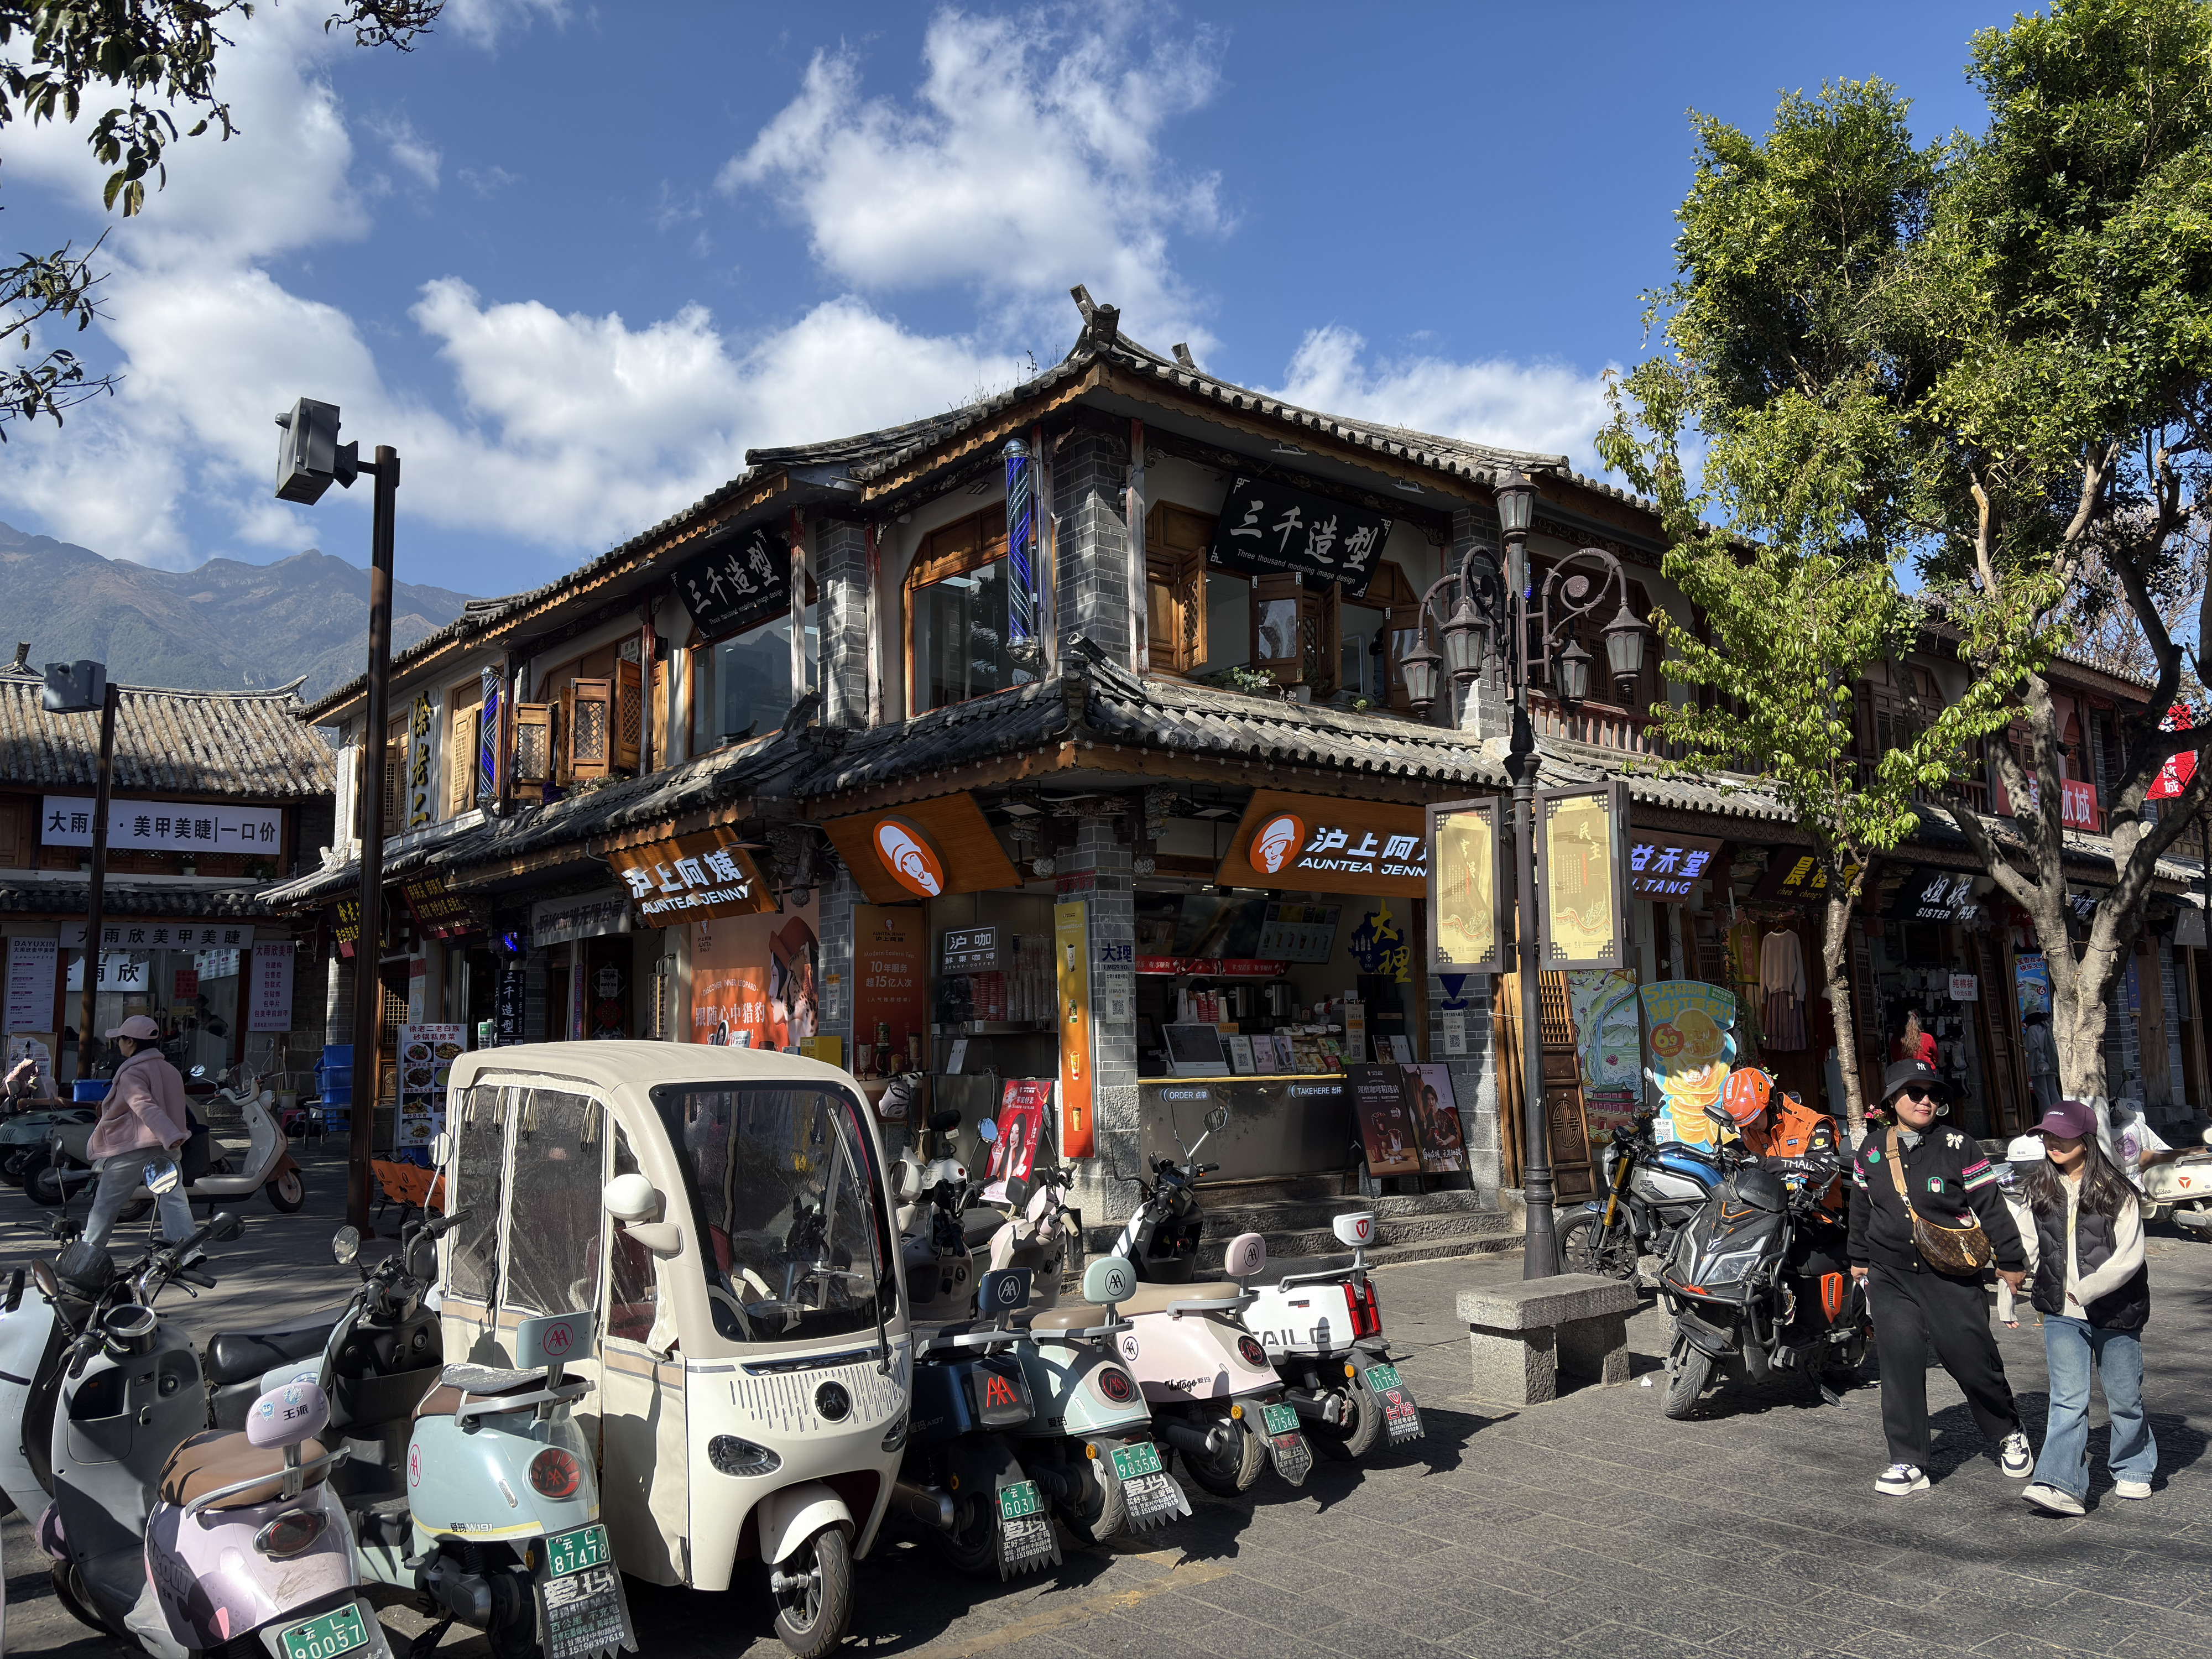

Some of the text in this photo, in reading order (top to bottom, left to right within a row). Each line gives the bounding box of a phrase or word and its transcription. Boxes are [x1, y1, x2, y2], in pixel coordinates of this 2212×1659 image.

[1230, 500, 1378, 572] 三千造型
[1238, 549, 1355, 585] Three thousand modeling image design
[687, 541, 780, 614] 三千造型
[708, 589, 784, 625] Three thousand modeling image design
[1305, 828, 1427, 860] 沪上阿
[1579, 821, 1601, 861] 民主
[1297, 858, 1373, 873] AUNTEA
[1631, 844, 1710, 878] 益禾堂
[621, 850, 743, 899] 沪上阿姨
[641, 884, 750, 915] AUNTEA JENNY
[1777, 887, 1793, 896] chen
[1916, 904, 1978, 920] SISTER 内衣
[949, 932, 992, 950] 沪咖
[1371, 899, 1412, 984] 大理
[255, 945, 293, 957] 大雨欣美甲
[945, 952, 995, 964] 鲜果咖啡
[1102, 943, 1132, 962] 大理
[67, 963, 140, 983] 雨欣
[870, 961, 907, 973] 10年服务
[2020, 963, 2044, 973] 快乐久久
[703, 981, 722, 996] DISCOVER
[738, 979, 757, 992] LEOPARD
[865, 975, 912, 988] 超15亿人次
[1952, 978, 1974, 988] 纯棉袜
[1642, 983, 1707, 1003] 5片鲜切橙
[501, 972, 516, 1034] 三千造型
[695, 1001, 765, 1027] 跟随心中猎豹
[1655, 1029, 1678, 1048] 6.9
[1169, 1091, 1207, 1100] ORDER 点单
[1331, 1086, 1342, 1094] 出杯
[1358, 1085, 1399, 1094] 现磨咖啡精选店
[1781, 1159, 1815, 1171] TMALL
[2154, 1188, 2172, 1197] yadea
[1165, 1379, 1197, 1392] Vintage
[1375, 1374, 1400, 1390] J1756
[283, 1404, 309, 1421] 王派
[1386, 1401, 1415, 1421] 台铃
[927, 1416, 944, 1426] A107
[1047, 1416, 1067, 1427] 爱玛
[1270, 1415, 1297, 1432] H7546
[1390, 1426, 1419, 1437] 15825170329
[1123, 1447, 1146, 1460] 云 A
[1279, 1446, 1305, 1460] 爱玛
[1119, 1456, 1159, 1477] 9835R
[1010, 1486, 1034, 1498] 云 L
[1123, 1474, 1169, 1498] 爱玛
[1005, 1495, 1043, 1516] G0314
[1126, 1486, 1175, 1506] 买好车 选爱玛
[1002, 1512, 1046, 1542] 爱玛
[562, 1530, 597, 1551] 云 L
[1003, 1530, 1050, 1551] 买好车 选爱玛
[554, 1542, 608, 1573] 87478
[543, 1566, 615, 1611] 爱玛
[550, 1604, 619, 1633] 百公里 不充电
[597, 1614, 621, 1629] 两年换新
[304, 1619, 345, 1641] 云 L
[295, 1624, 361, 1659] 90057
